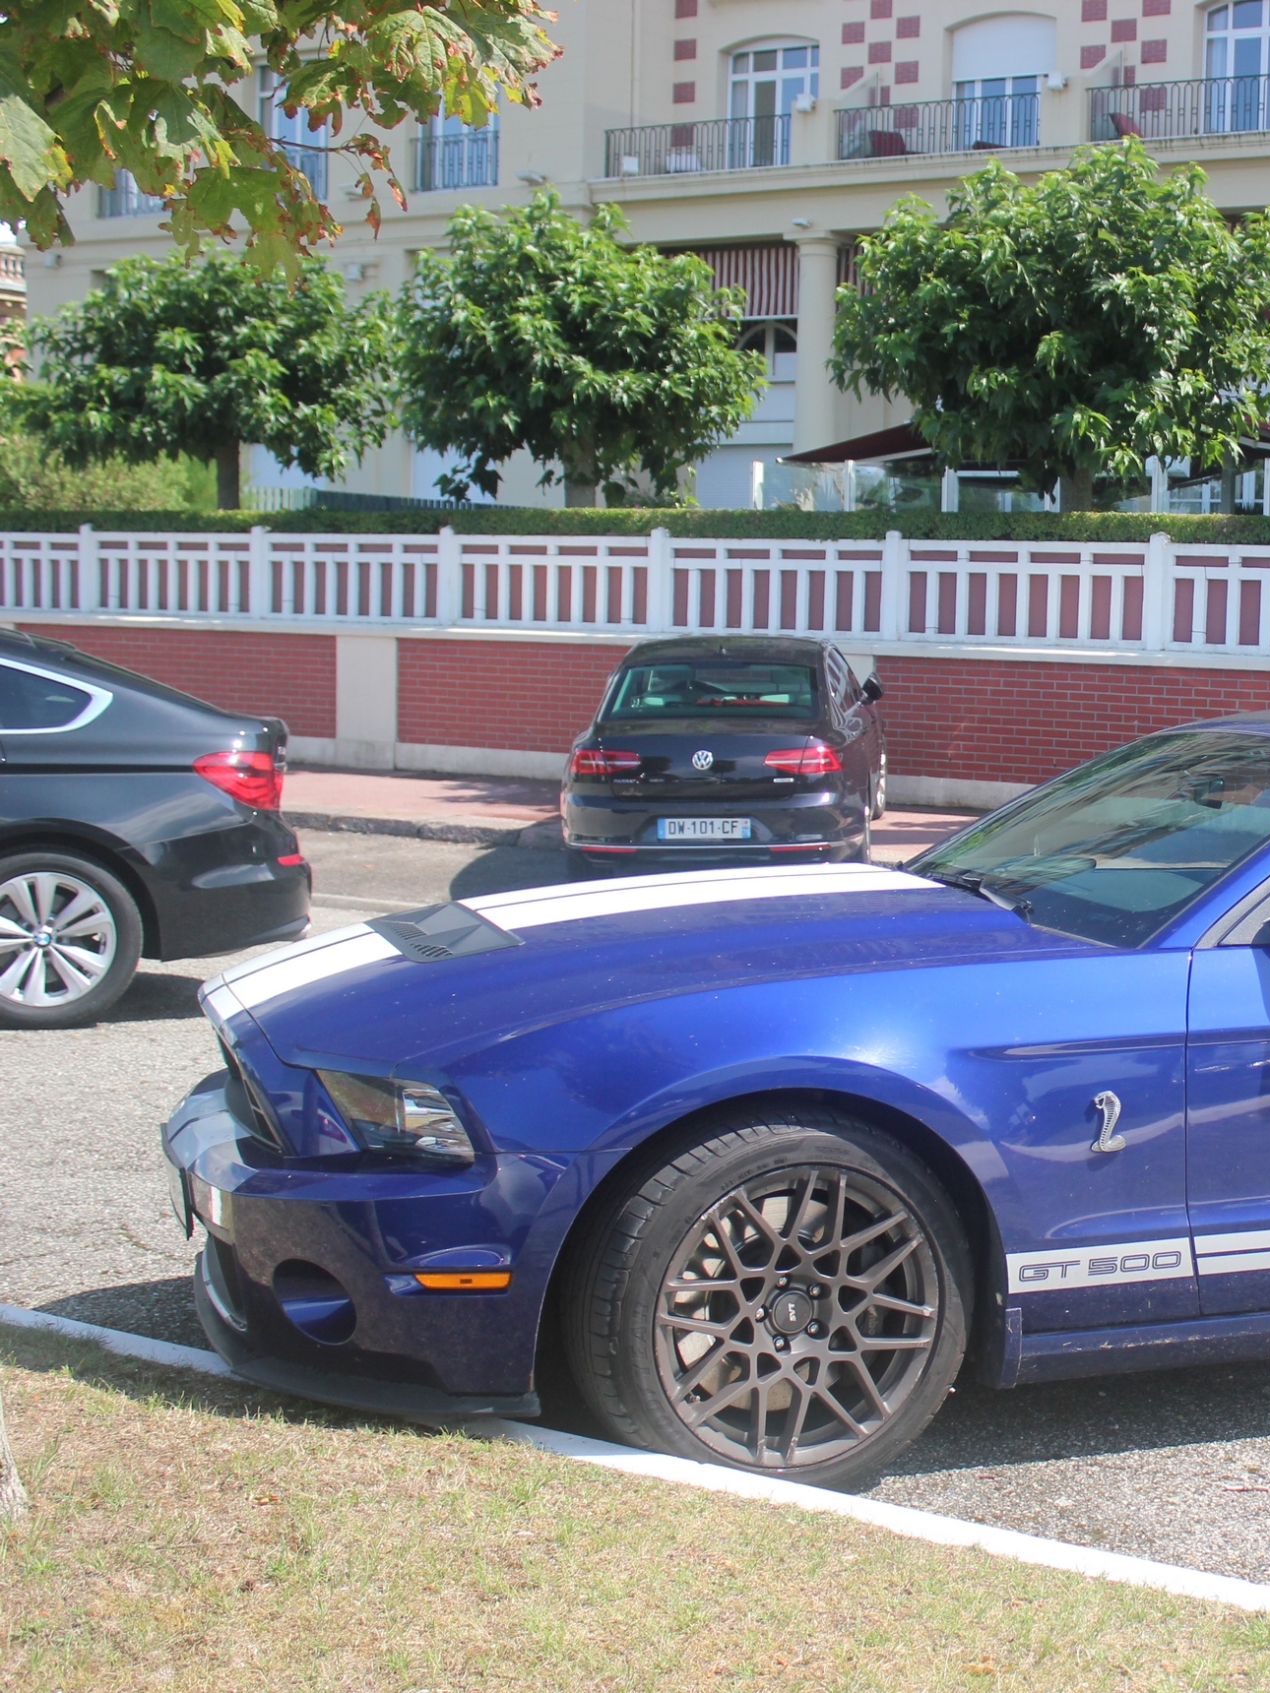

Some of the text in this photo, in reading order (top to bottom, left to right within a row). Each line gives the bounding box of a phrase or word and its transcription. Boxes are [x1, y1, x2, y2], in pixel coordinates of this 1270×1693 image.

[668, 820, 738, 835] DW-101-CF
[1019, 1250, 1182, 1282] GT 500
